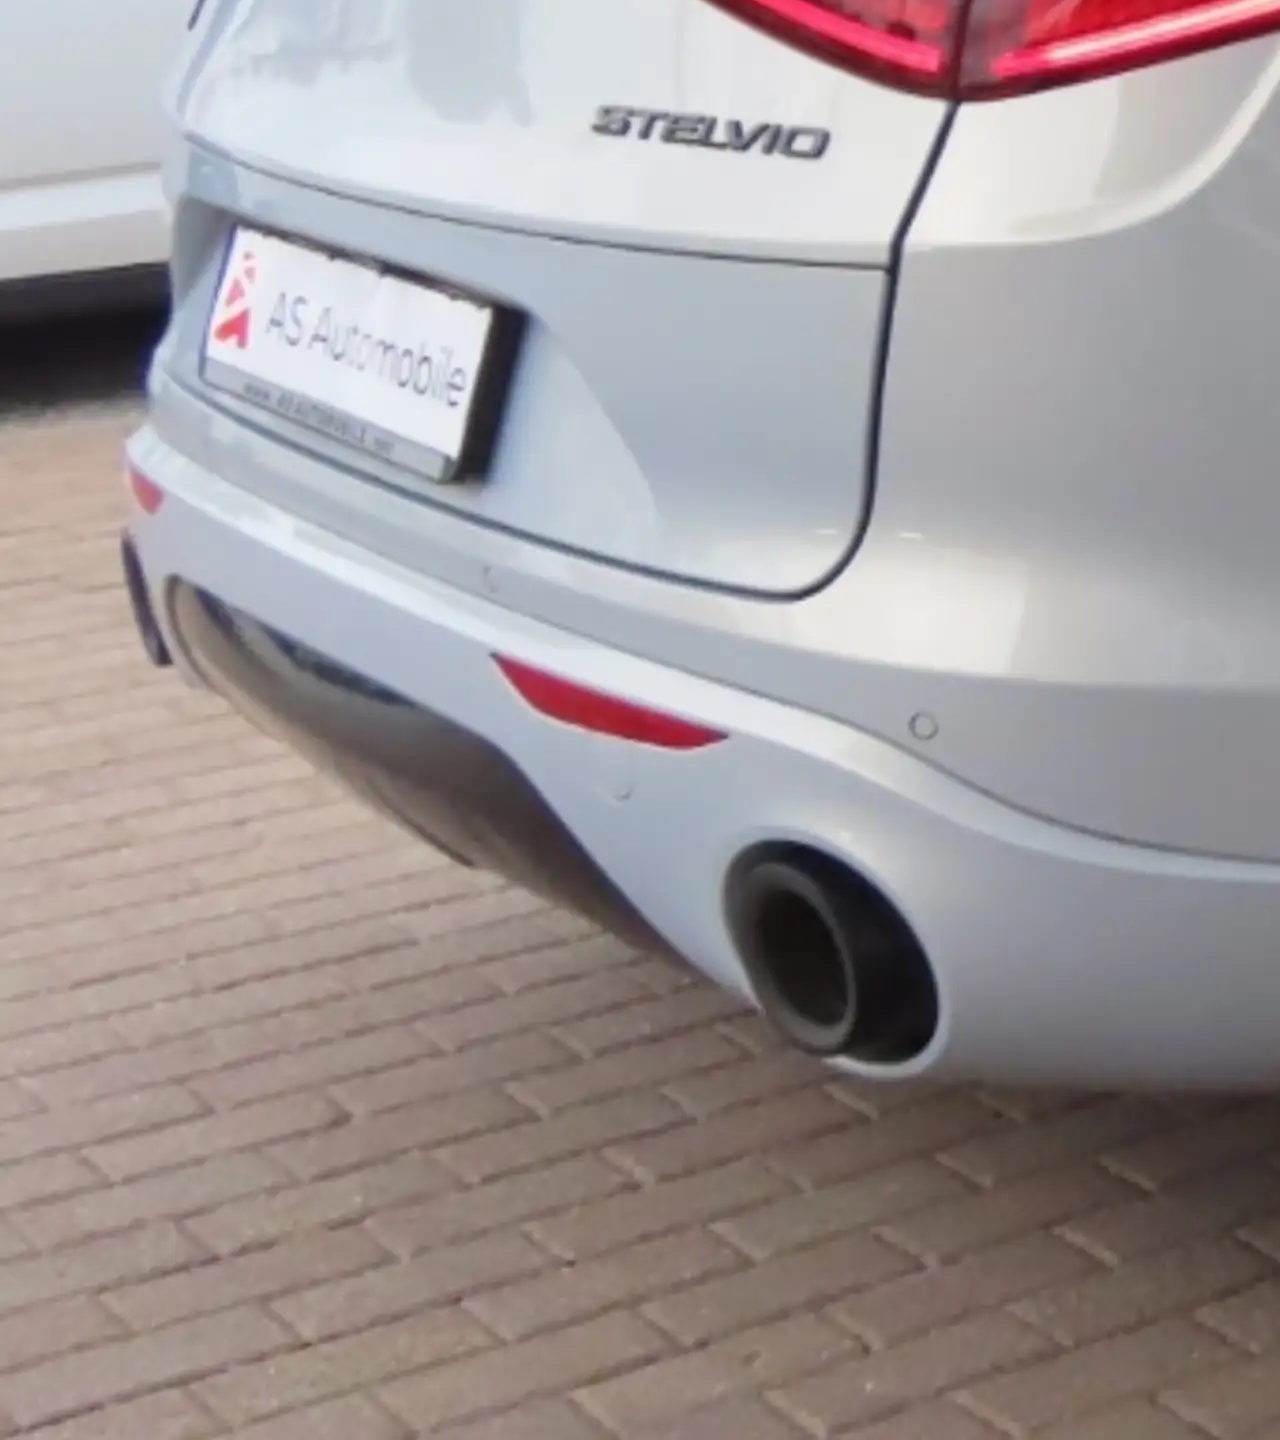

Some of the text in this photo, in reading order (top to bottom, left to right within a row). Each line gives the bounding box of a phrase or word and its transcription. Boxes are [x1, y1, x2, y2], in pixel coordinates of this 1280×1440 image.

[592, 105, 831, 160] STELVIO
[265, 291, 467, 408] AS Automobile
